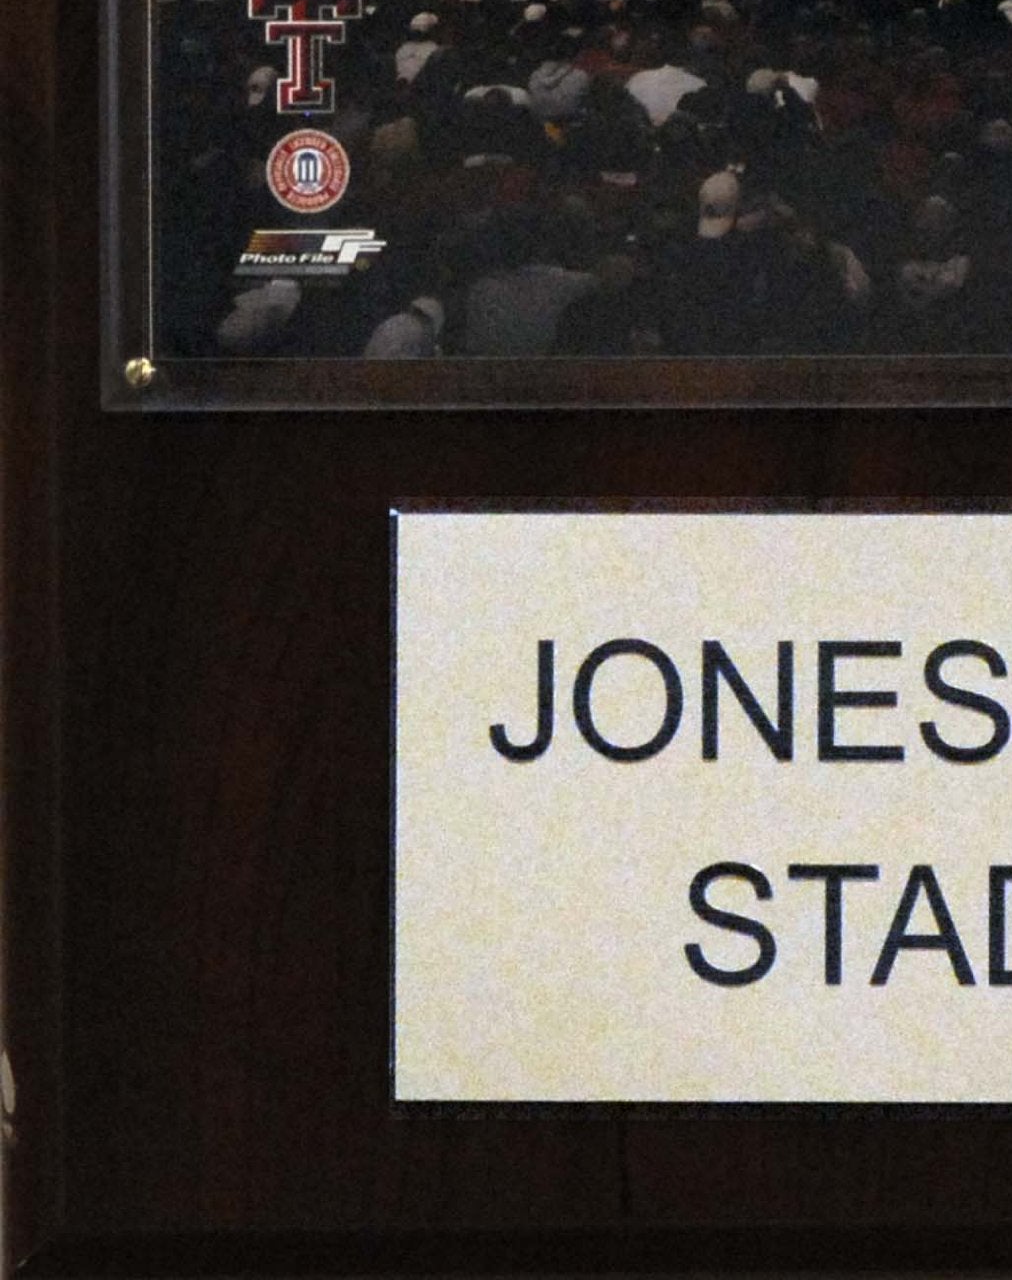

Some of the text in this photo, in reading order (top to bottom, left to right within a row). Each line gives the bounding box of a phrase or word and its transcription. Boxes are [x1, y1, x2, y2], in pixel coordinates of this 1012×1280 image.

[239, 252, 334, 264] Photo File
[489, 638, 1011, 765] JONES
